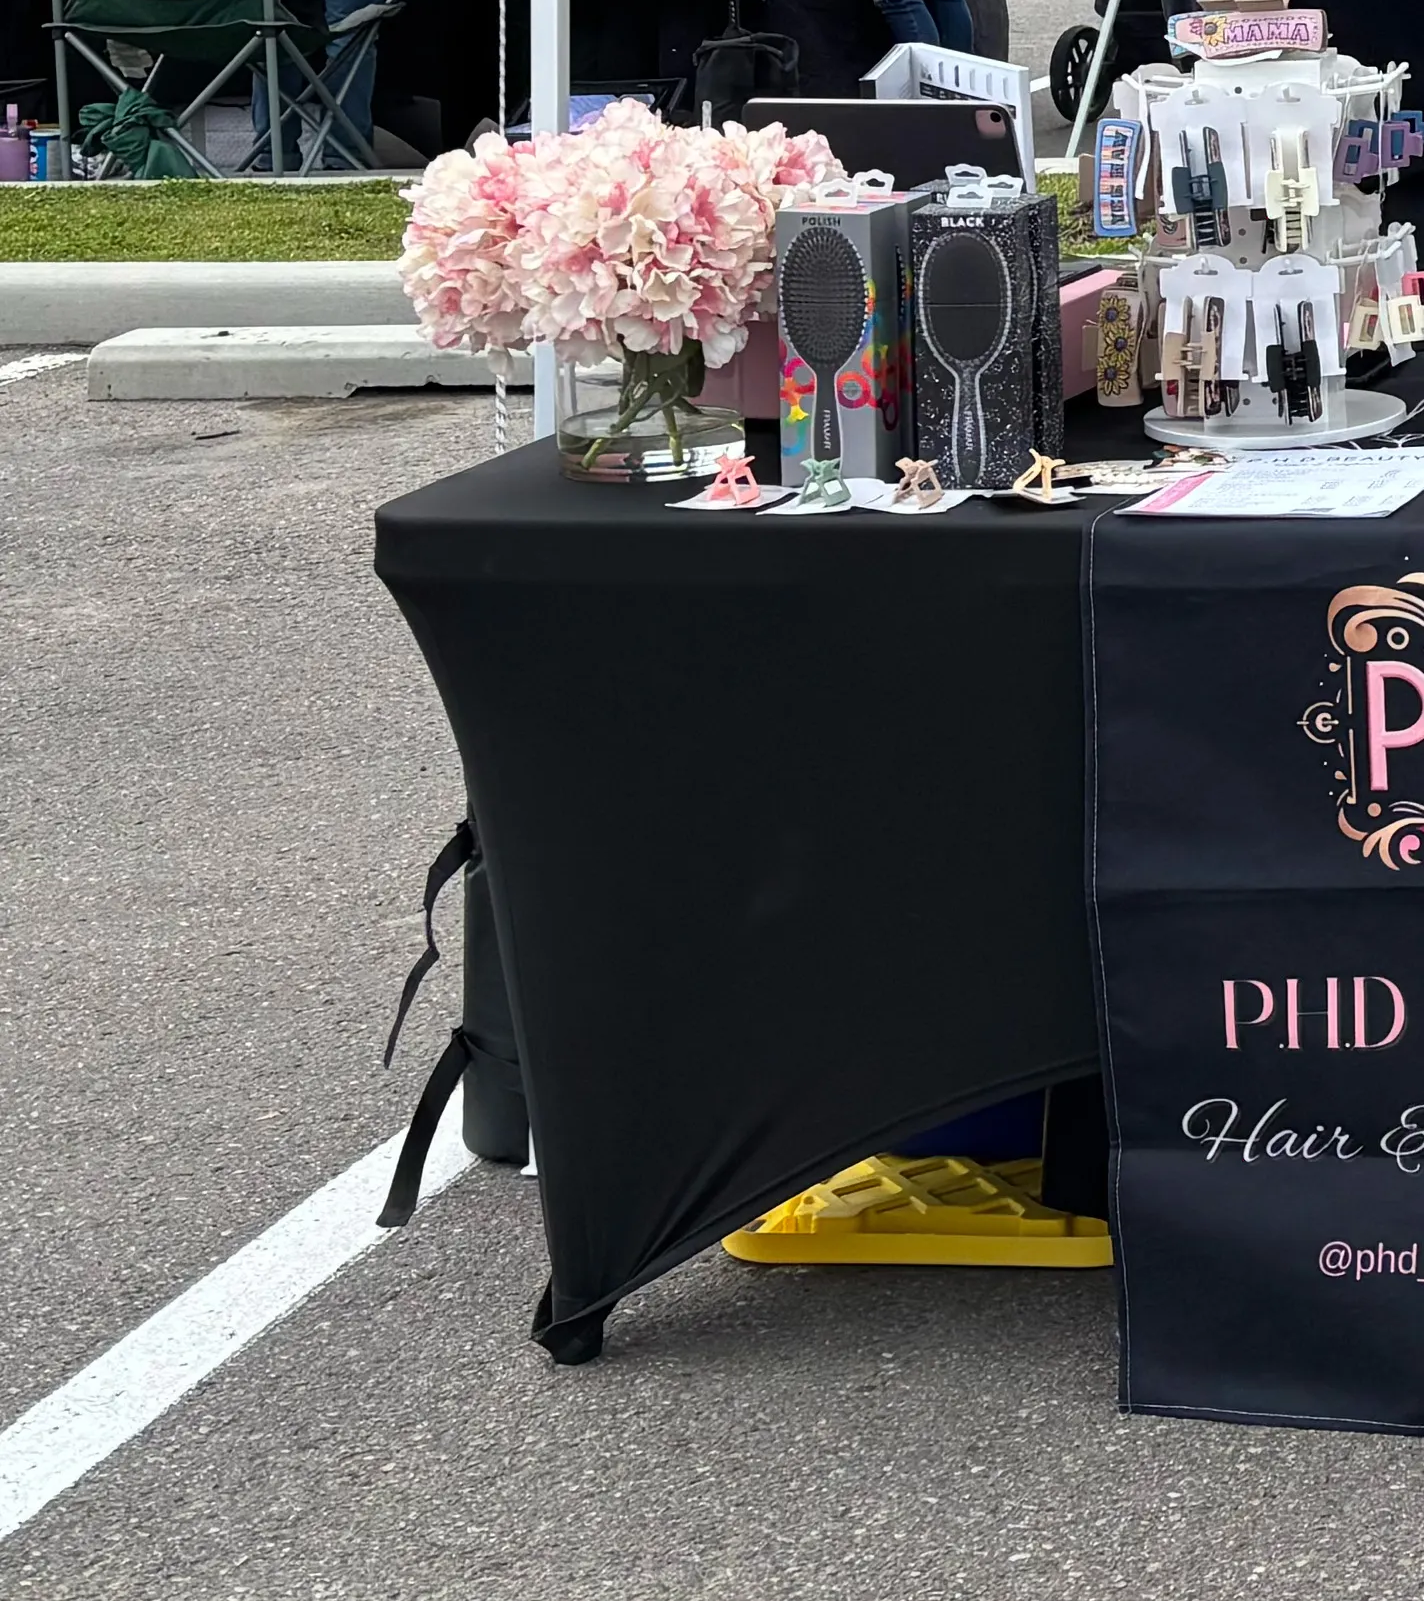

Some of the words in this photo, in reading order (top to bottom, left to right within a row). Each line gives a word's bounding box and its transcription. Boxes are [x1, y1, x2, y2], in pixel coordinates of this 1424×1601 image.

[1222, 21, 1311, 44] MAMA
[801, 216, 842, 227] POLISH
[940, 216, 985, 228] BLACK
[1181, 1097, 1365, 1167] Hair
